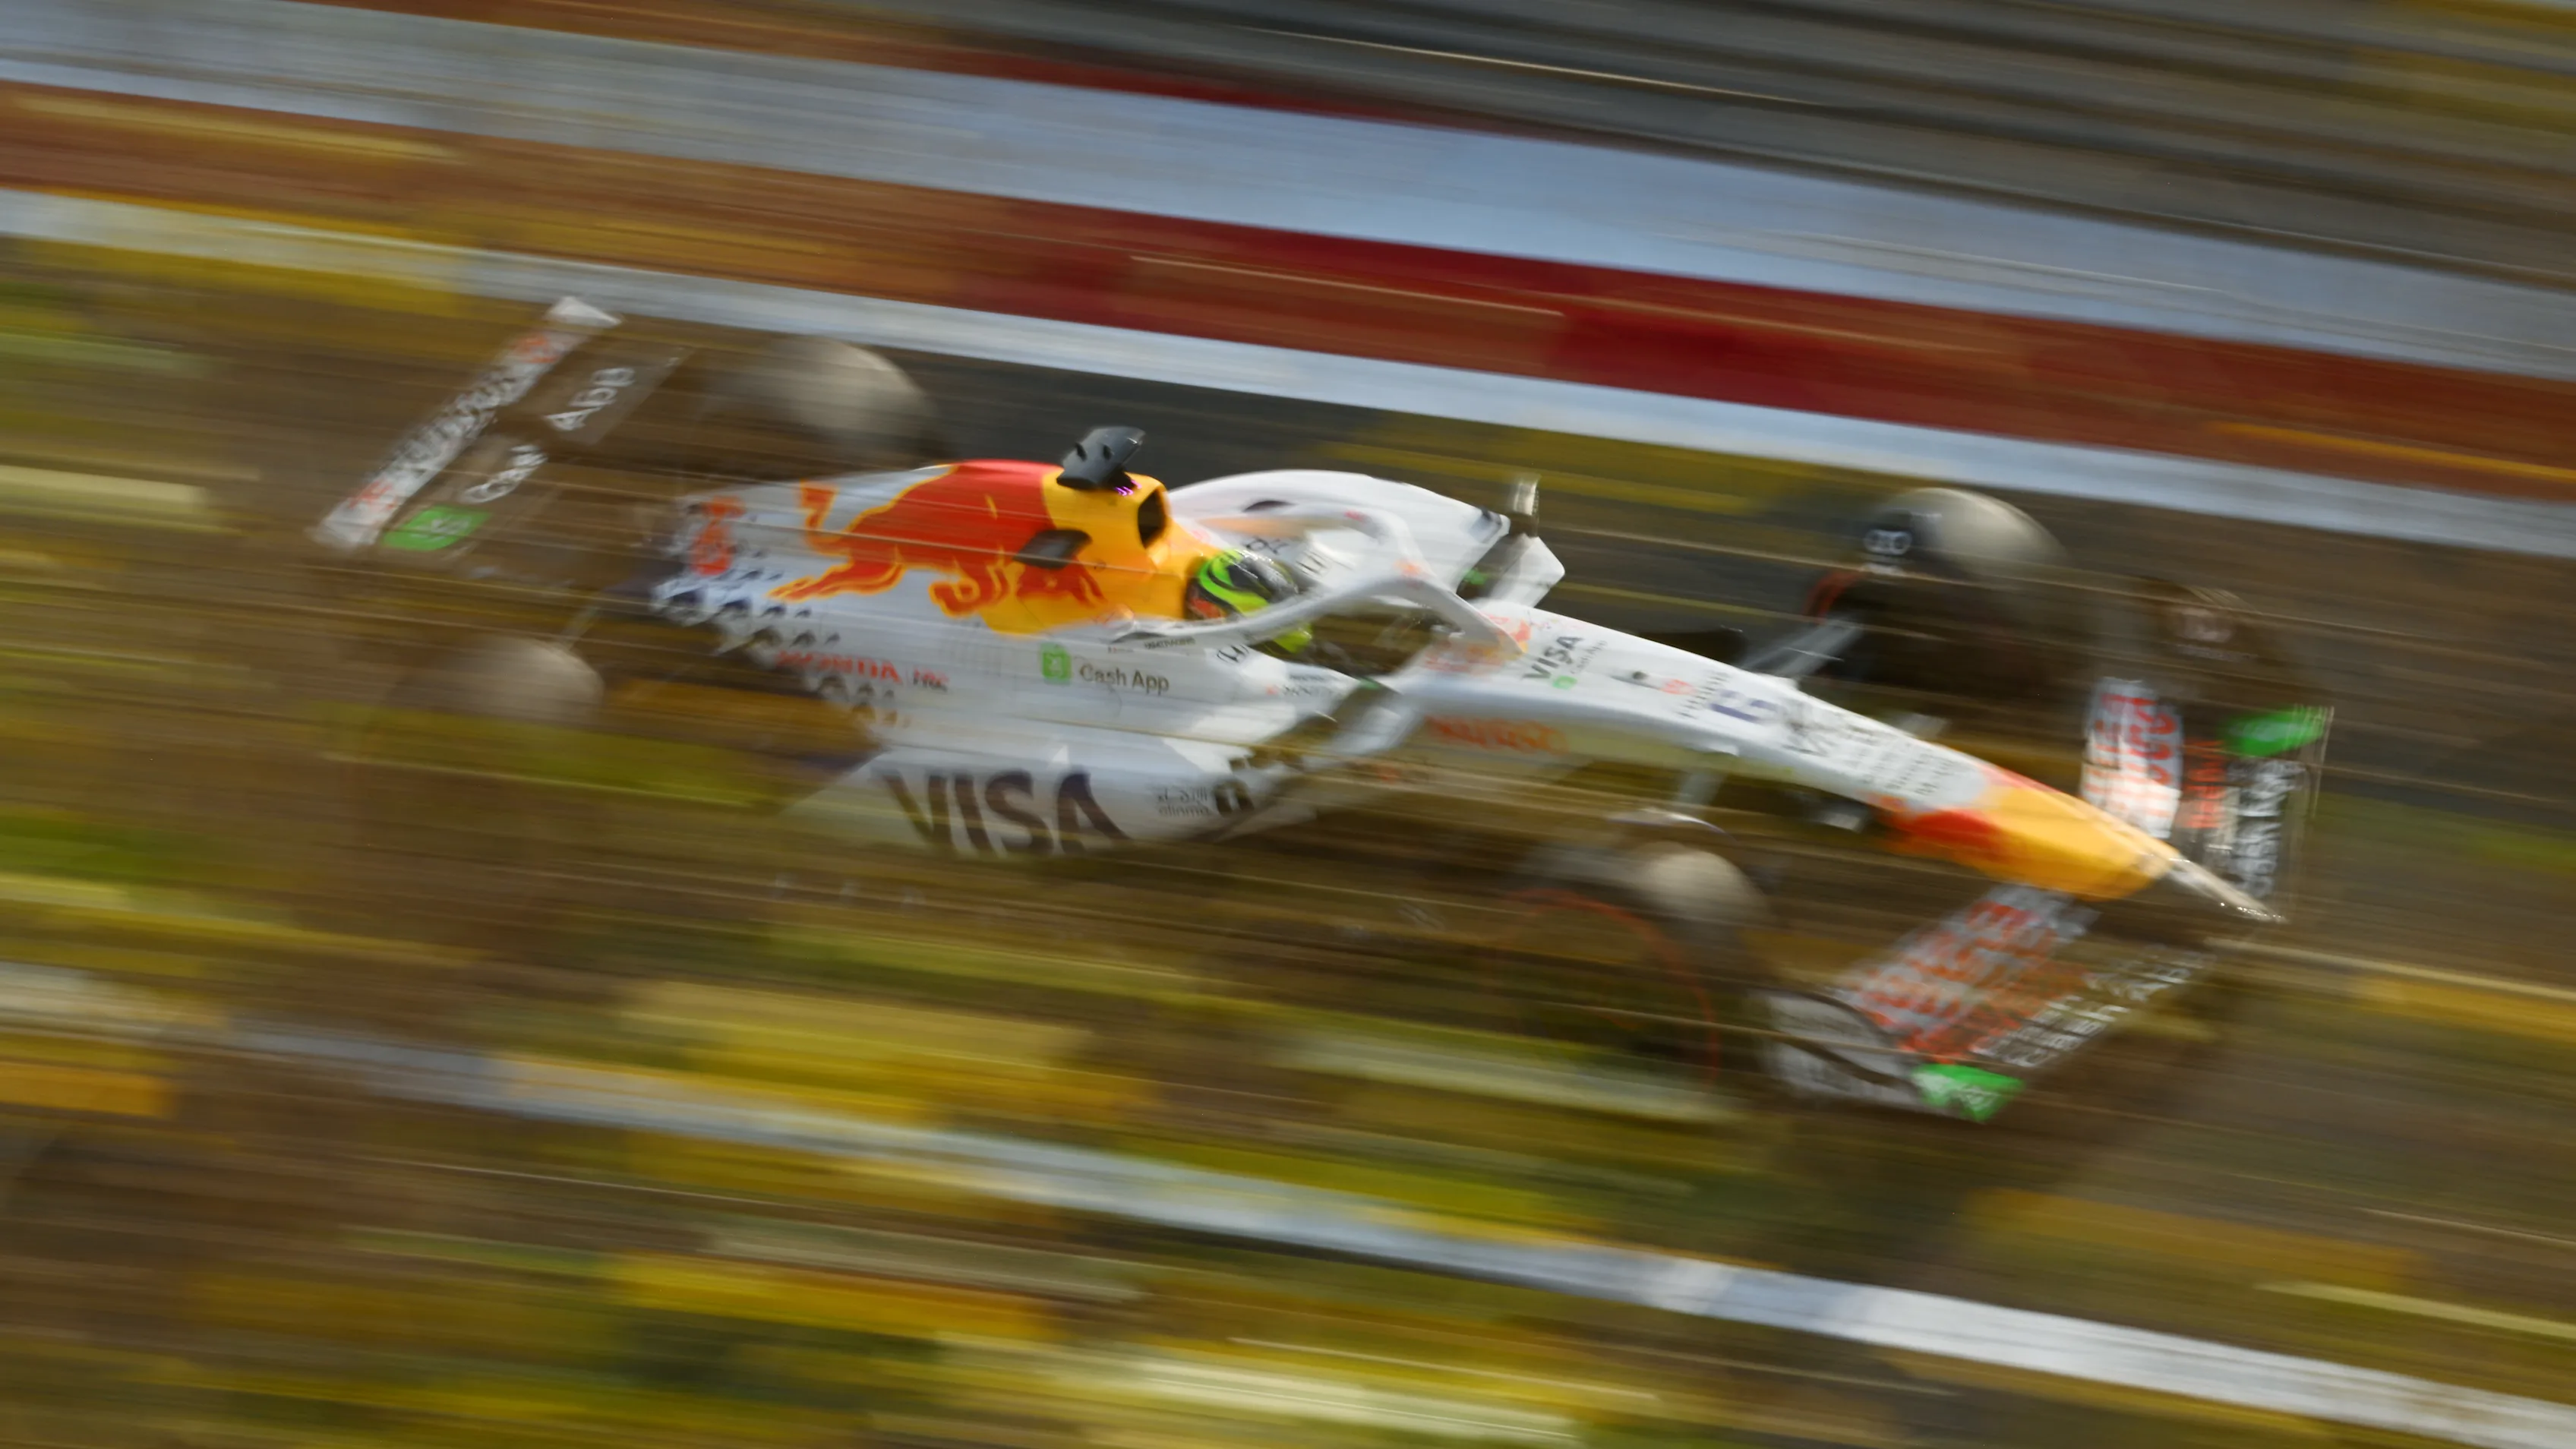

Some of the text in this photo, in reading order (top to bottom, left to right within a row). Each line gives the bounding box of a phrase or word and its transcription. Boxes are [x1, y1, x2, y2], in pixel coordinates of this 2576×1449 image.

[1079, 662, 1170, 696] Cash App
[1521, 636, 1584, 680] VISA
[878, 769, 1133, 855] VISA
